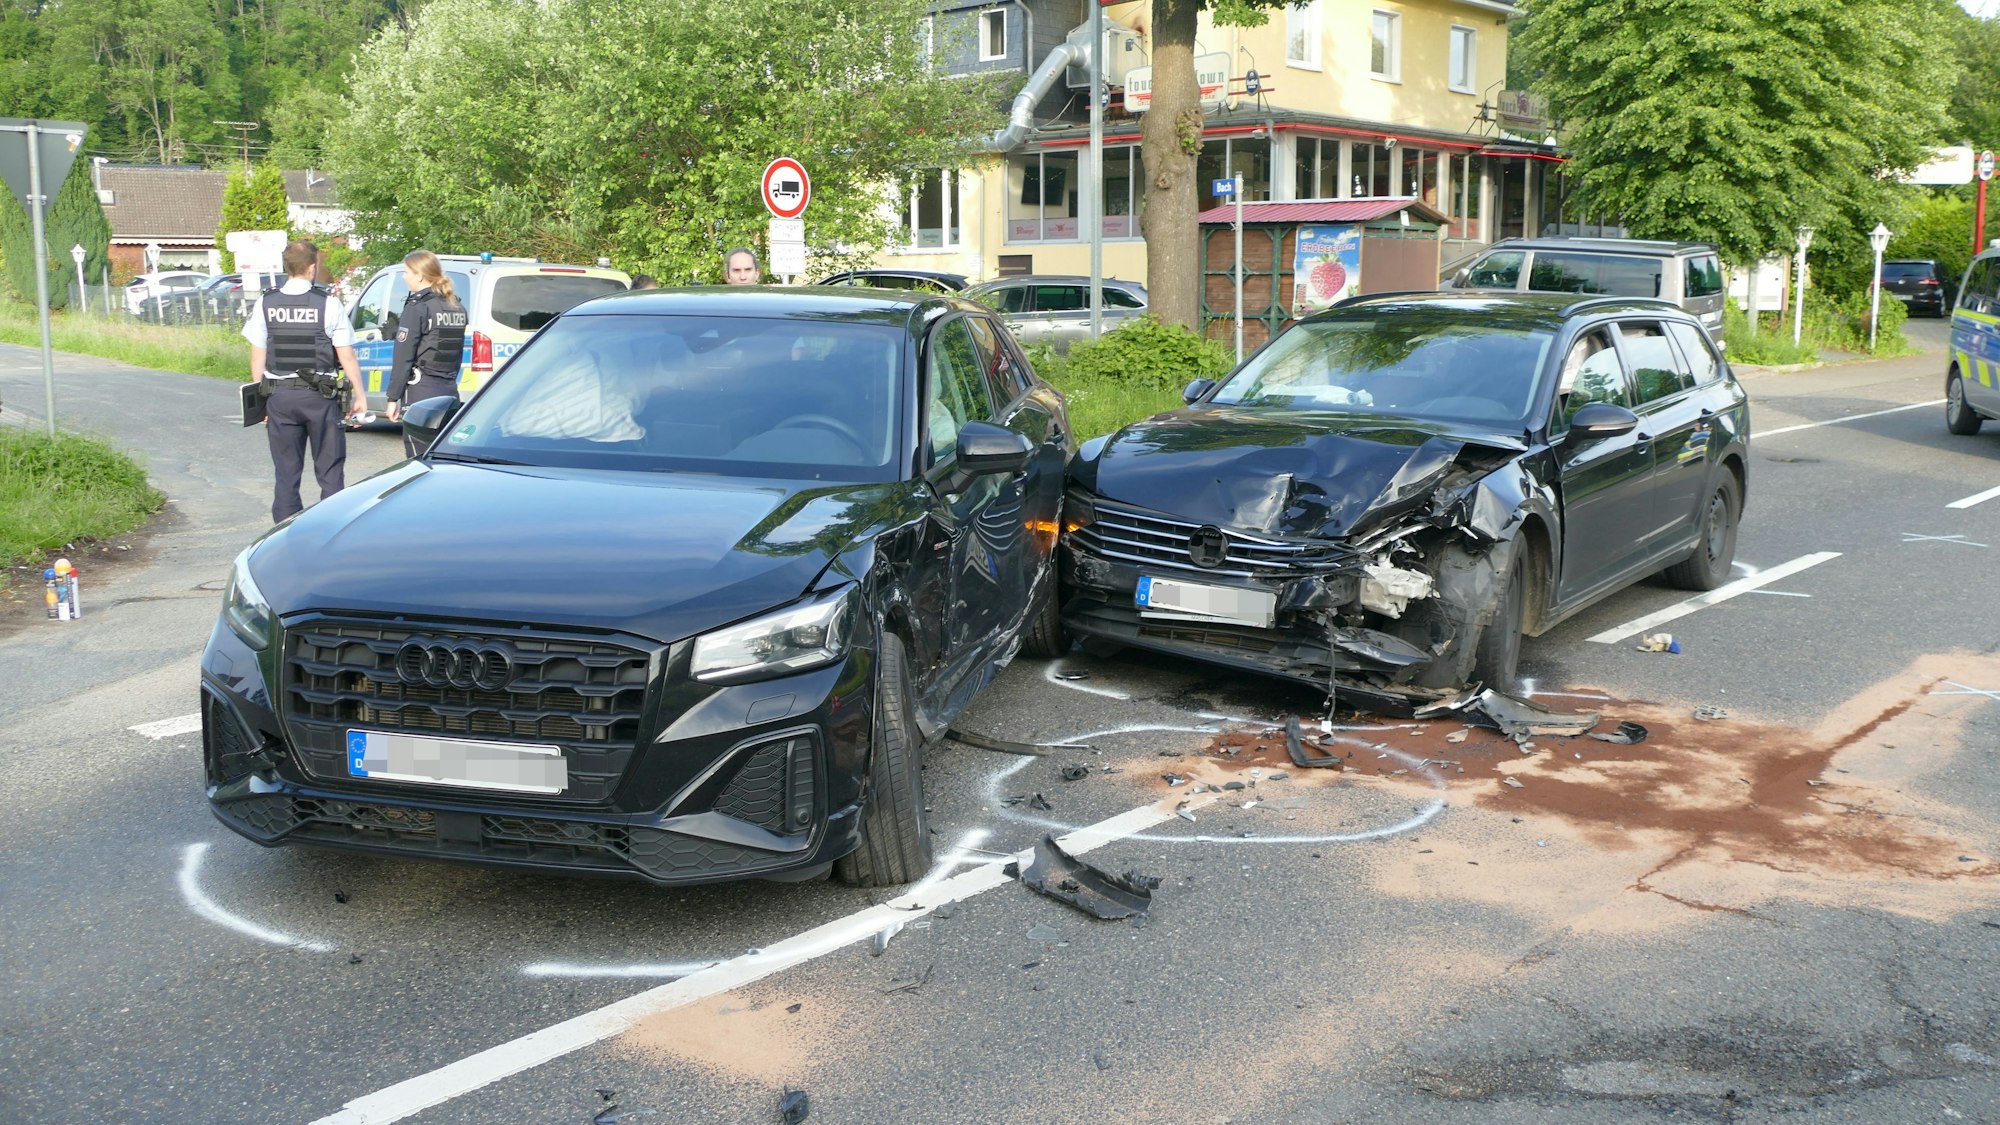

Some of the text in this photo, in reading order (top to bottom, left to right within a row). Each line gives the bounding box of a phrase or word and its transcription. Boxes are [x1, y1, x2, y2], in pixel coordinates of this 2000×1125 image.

[1216, 182, 1232, 193] Bach
[267, 307, 319, 324] POLIZEI
[436, 312, 467, 326] POLIZEI
[1140, 593, 1146, 601] D
[355, 758, 363, 769] D
